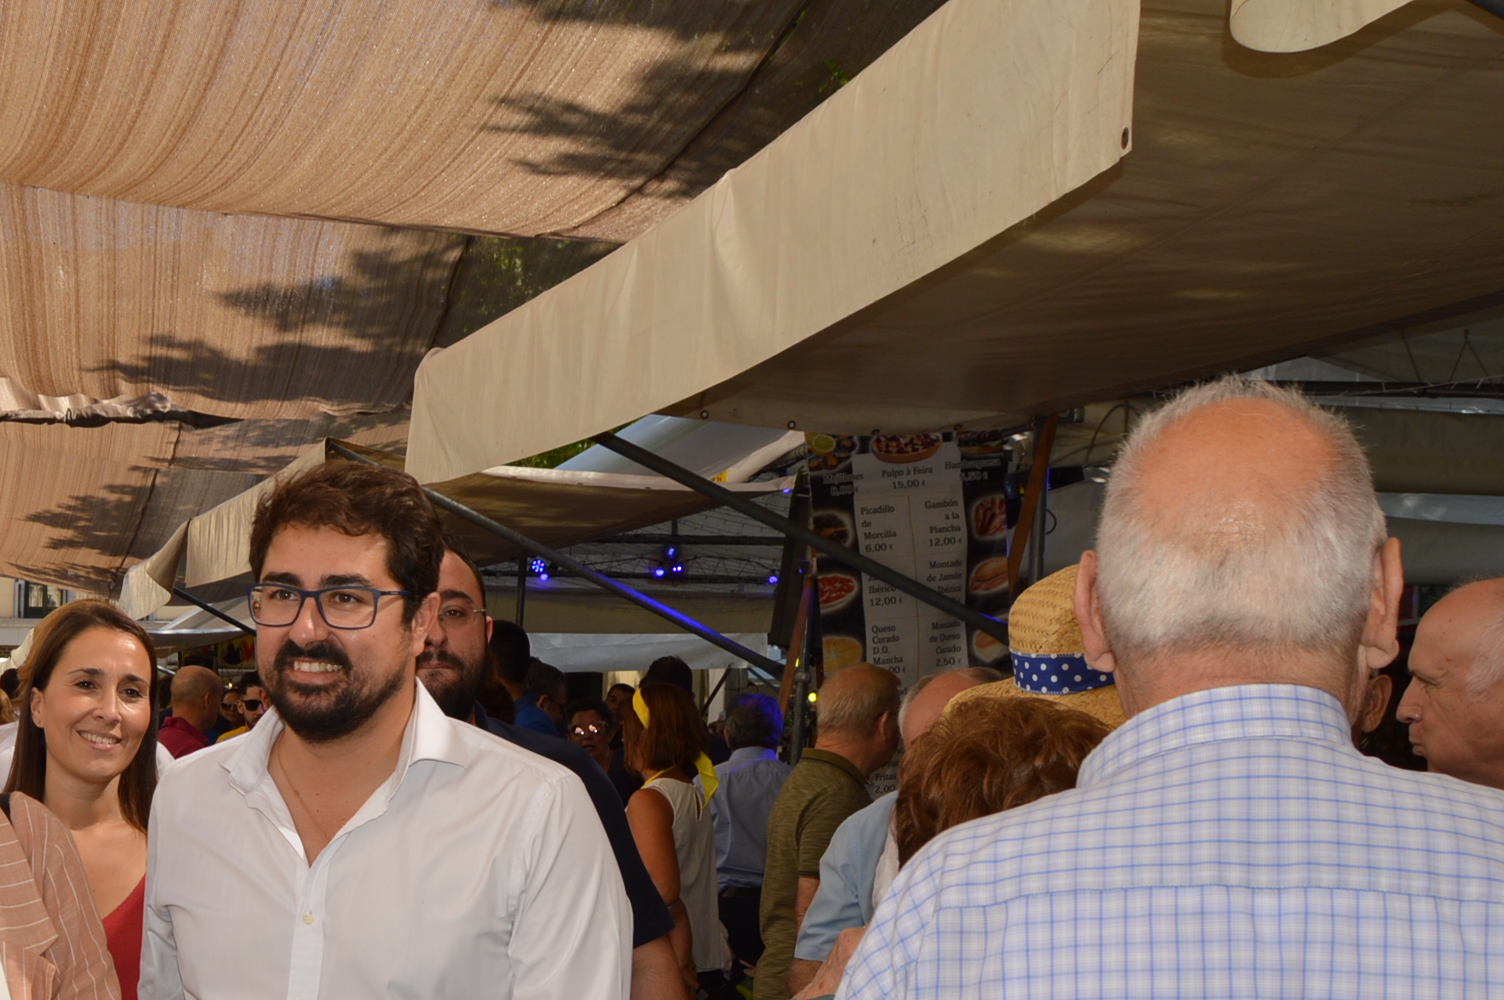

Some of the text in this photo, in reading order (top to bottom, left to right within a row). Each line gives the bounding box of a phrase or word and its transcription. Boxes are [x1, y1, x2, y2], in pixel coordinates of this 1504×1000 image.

[945, 458, 1001, 470] Hamburguesa
[882, 469, 904, 478] Pulpo
[913, 466, 933, 474] Feira
[823, 473, 864, 484] Mejillones
[925, 499, 958, 509] Gambón
[861, 505, 895, 515] Picadillo
[930, 525, 961, 533] Plancha
[864, 530, 897, 539] Morcilla
[929, 560, 962, 569] Montado
[927, 572, 962, 582] de Jamón
[869, 585, 896, 594] Ibérico
[938, 585, 962, 593] Ibérico
[872, 625, 896, 634] Queso
[931, 621, 960, 630] Montado
[872, 635, 899, 644] Curado
[940, 633, 960, 642] Queso
[936, 646, 961, 654] Curado
[874, 656, 903, 665] Mancha
[875, 773, 896, 781] Fritas
